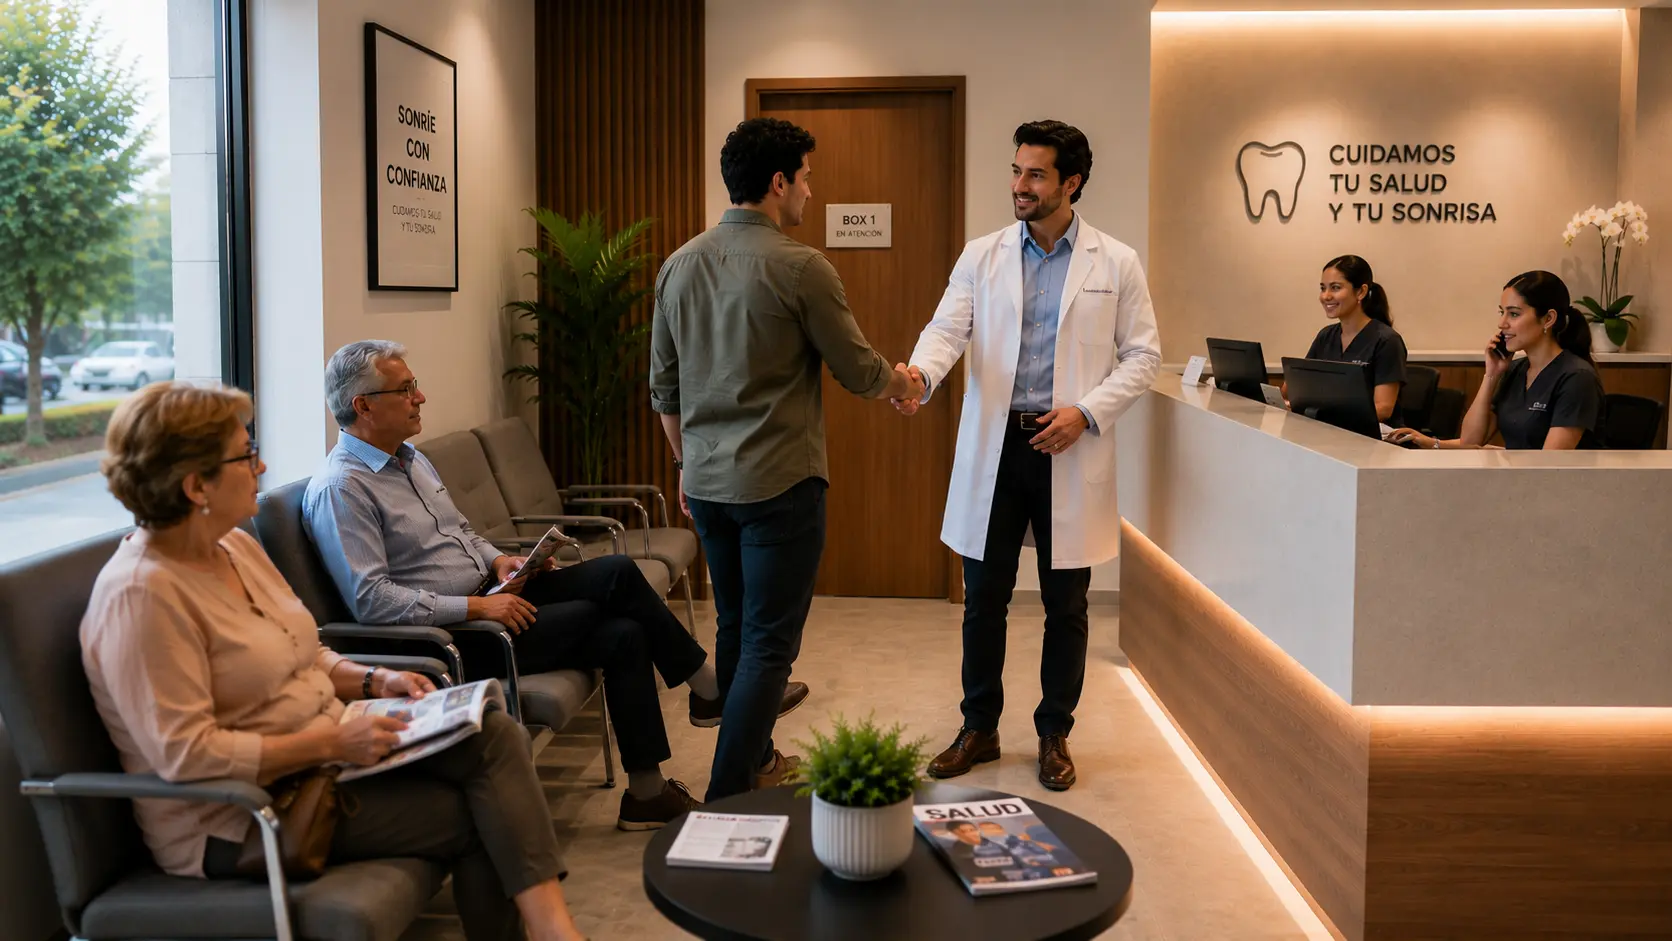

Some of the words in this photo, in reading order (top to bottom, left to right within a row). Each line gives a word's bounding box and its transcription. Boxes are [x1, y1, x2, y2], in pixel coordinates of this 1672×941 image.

[398, 104, 436, 134] SONRÍE
[407, 138, 430, 161] CON
[1329, 144, 1456, 166] CUIDAMOS
[387, 164, 447, 194] CONFIANZA
[1329, 173, 1360, 194] TU
[1369, 173, 1448, 195] SALUD
[843, 215, 867, 225] BOX
[870, 215, 875, 225] 1
[1328, 202, 1343, 222] Y
[1352, 202, 1383, 223] TU
[1391, 202, 1497, 224] SONRISA
[925, 803, 1022, 820] SALUD
